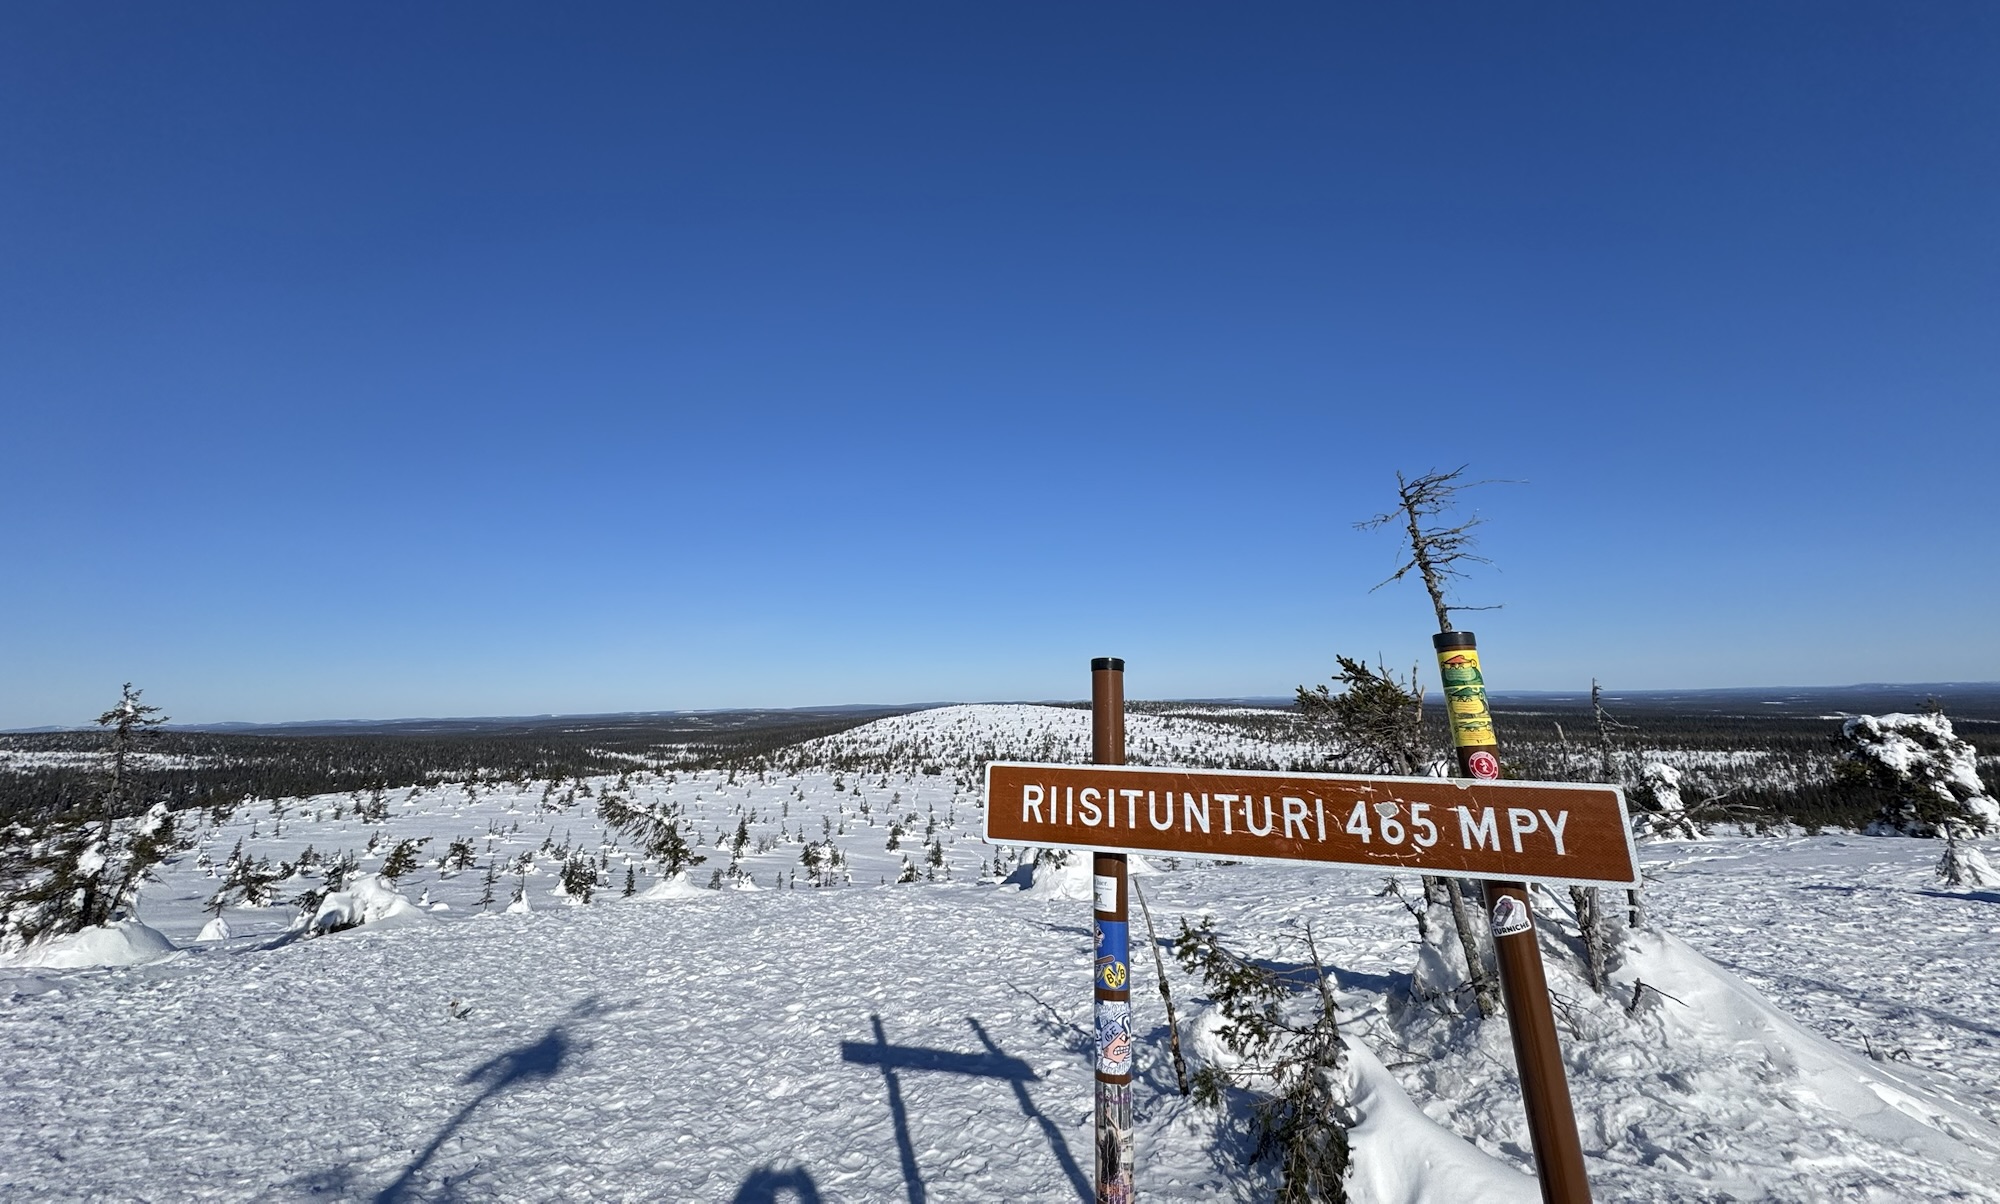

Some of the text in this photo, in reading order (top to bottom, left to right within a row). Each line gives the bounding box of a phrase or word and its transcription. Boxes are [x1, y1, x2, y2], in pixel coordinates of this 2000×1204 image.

[1022, 784, 1569, 856] RIISITUNTURI 465 MPY
